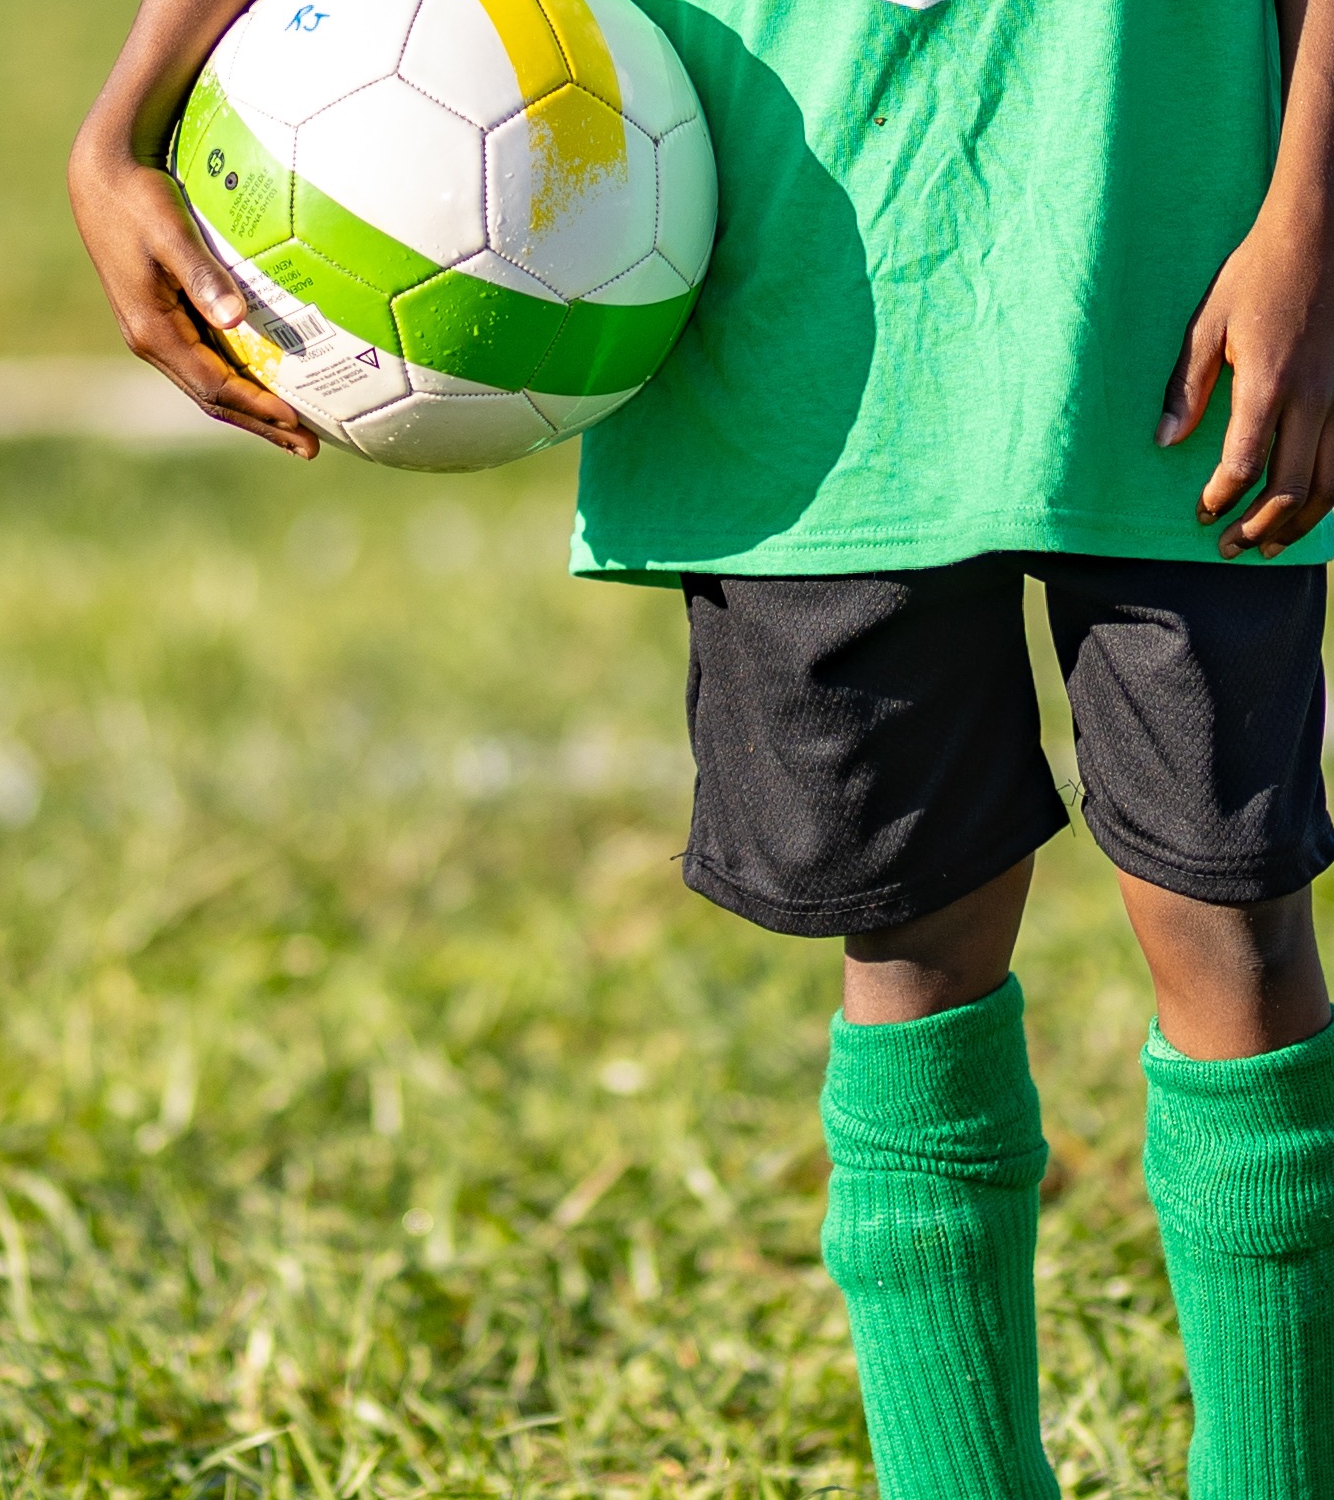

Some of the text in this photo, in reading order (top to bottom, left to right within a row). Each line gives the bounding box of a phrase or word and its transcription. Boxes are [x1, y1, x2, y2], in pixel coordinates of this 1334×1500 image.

[284, 4, 330, 32] RJ
[229, 167, 270, 234] MOISTEN NEEDLE
[238, 206, 256, 238] INFLATE
[261, 177, 274, 193] LBS
[246, 213, 262, 238] CHINA
[279, 269, 301, 285] 19015
[286, 277, 314, 294] BADEN
